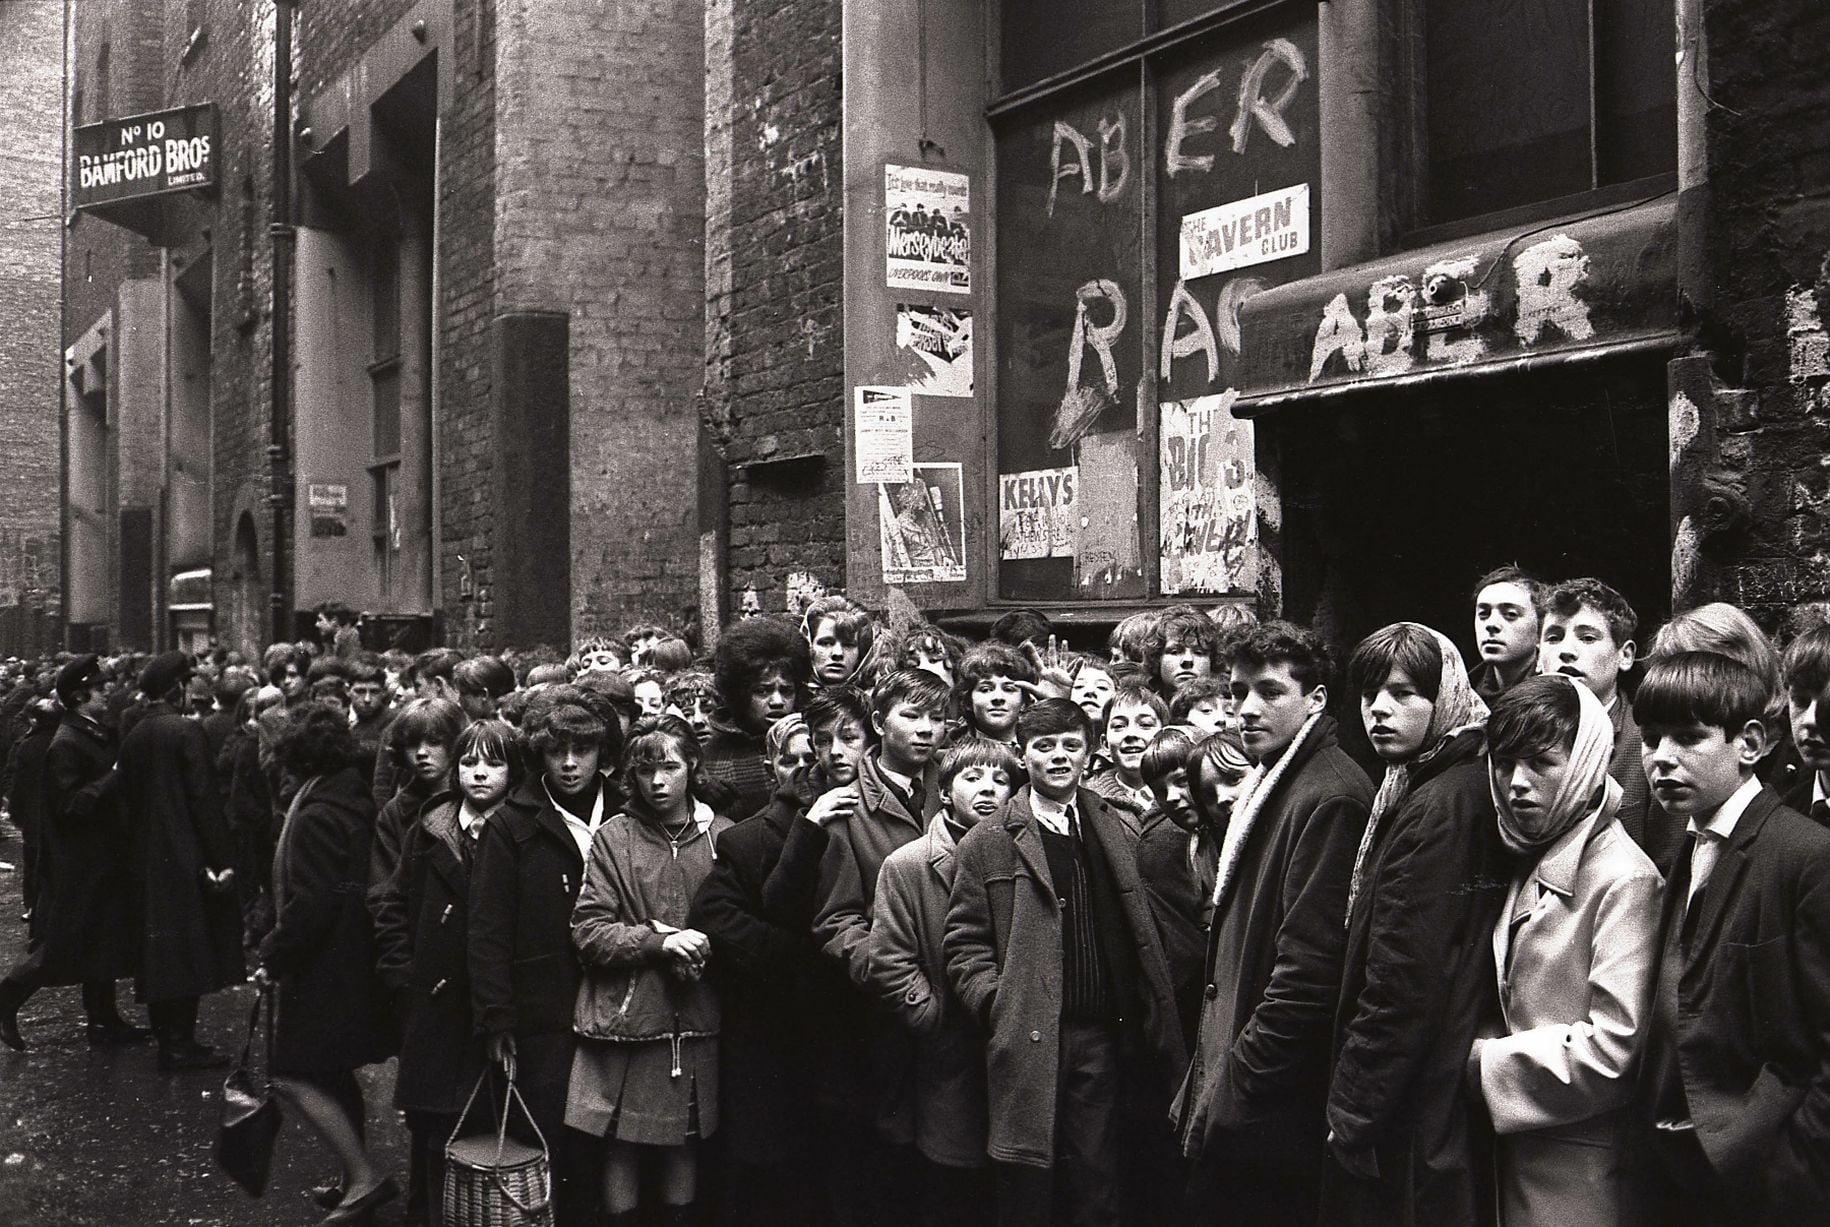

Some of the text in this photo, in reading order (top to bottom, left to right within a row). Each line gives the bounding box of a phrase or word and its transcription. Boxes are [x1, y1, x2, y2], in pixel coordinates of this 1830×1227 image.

[147, 121, 165, 140] 10
[79, 145, 162, 188] BAMFORD
[1261, 231, 1298, 256] CLUB
